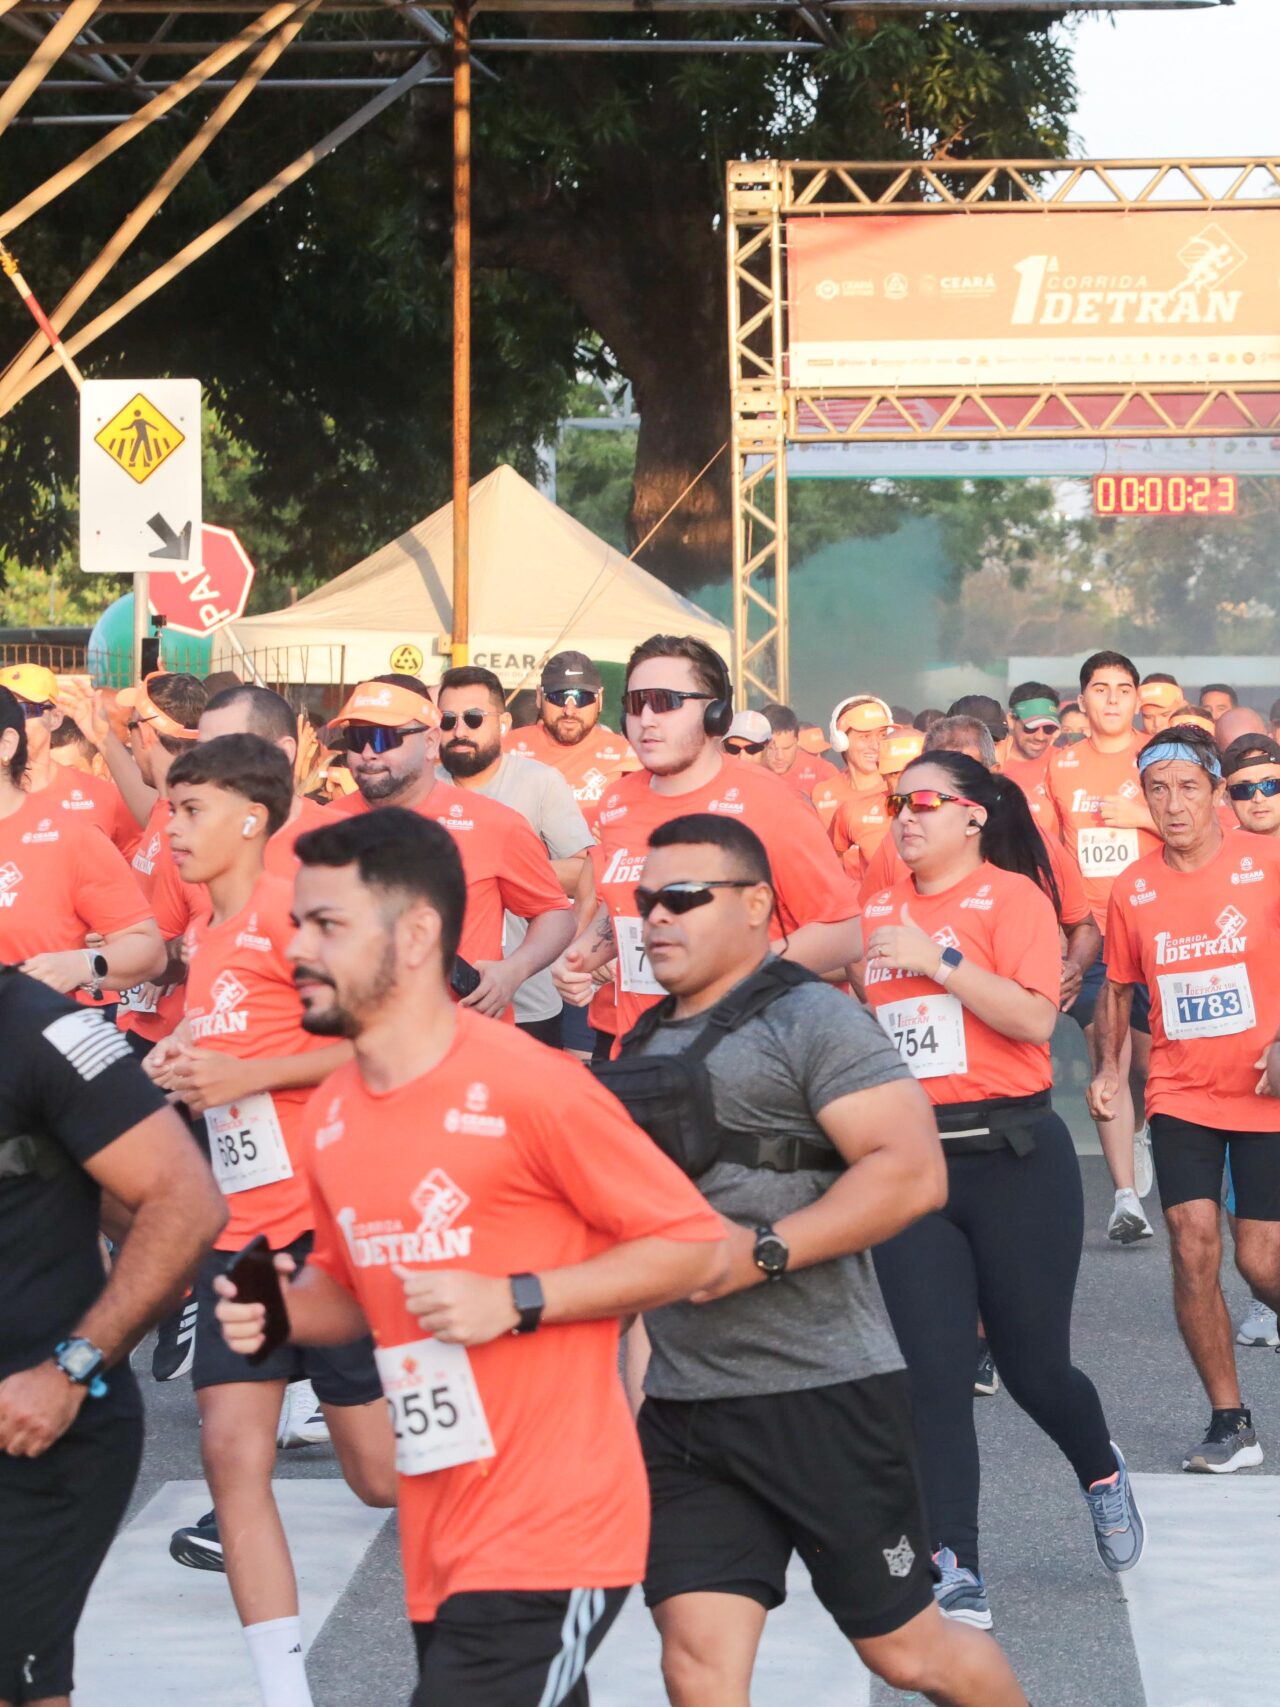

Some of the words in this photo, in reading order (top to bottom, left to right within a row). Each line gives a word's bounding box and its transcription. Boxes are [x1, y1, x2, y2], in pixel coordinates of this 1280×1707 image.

[940, 273, 996, 288] CEARÁ
[1047, 275, 1148, 290] CORRIDA
[1039, 290, 1243, 325] DETRAN
[1098, 477, 1234, 512] 00:00:23
[1082, 844, 1129, 864] 1020
[1166, 933, 1208, 947] CORRIDA
[1166, 936, 1247, 963] DETRAN
[1179, 992, 1241, 1021] 1783
[893, 1025, 939, 1057] 754
[351, 1225, 473, 1268] DETRAN
